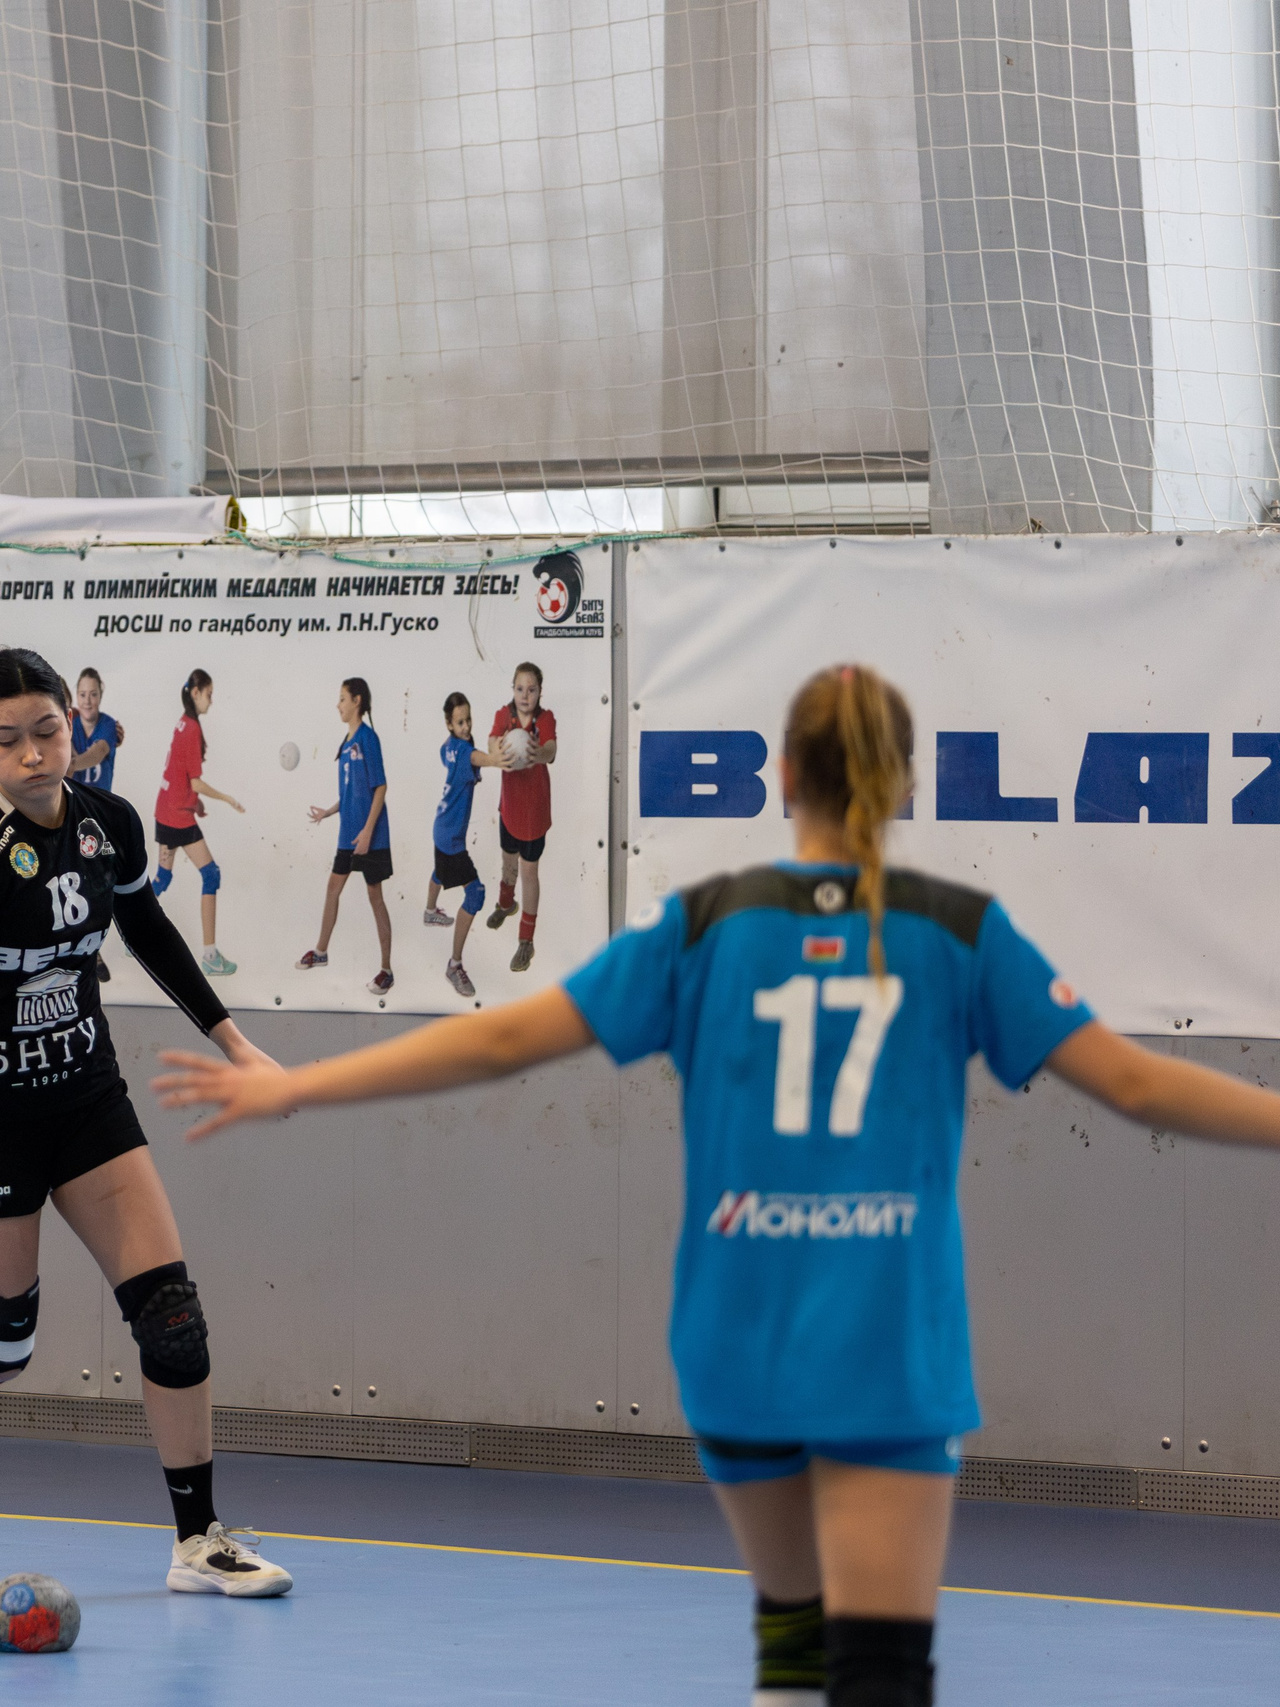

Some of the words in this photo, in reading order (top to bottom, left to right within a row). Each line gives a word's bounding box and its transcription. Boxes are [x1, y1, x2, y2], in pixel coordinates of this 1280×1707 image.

[63, 581, 75, 600] К
[84, 572, 217, 600] ОЛИМПИЙСКИМ
[226, 578, 317, 598] МЕДАЛЯМ
[326, 575, 445, 597] НАЧИНАЕТСЯ
[453, 574, 520, 595] ЗДЕСЬ!
[581, 599, 604, 612] БНТУ
[94, 615, 163, 637] ДЮСШ
[169, 619, 192, 633] по
[199, 613, 291, 637] гандболу
[298, 619, 331, 632] им.
[337, 612, 439, 636] Л.Н.Гуско
[639, 730, 1280, 825] BLA
[45, 871, 91, 932] 18
[753, 974, 904, 1138] 17
[32, 1070, 68, 1087] 1920
